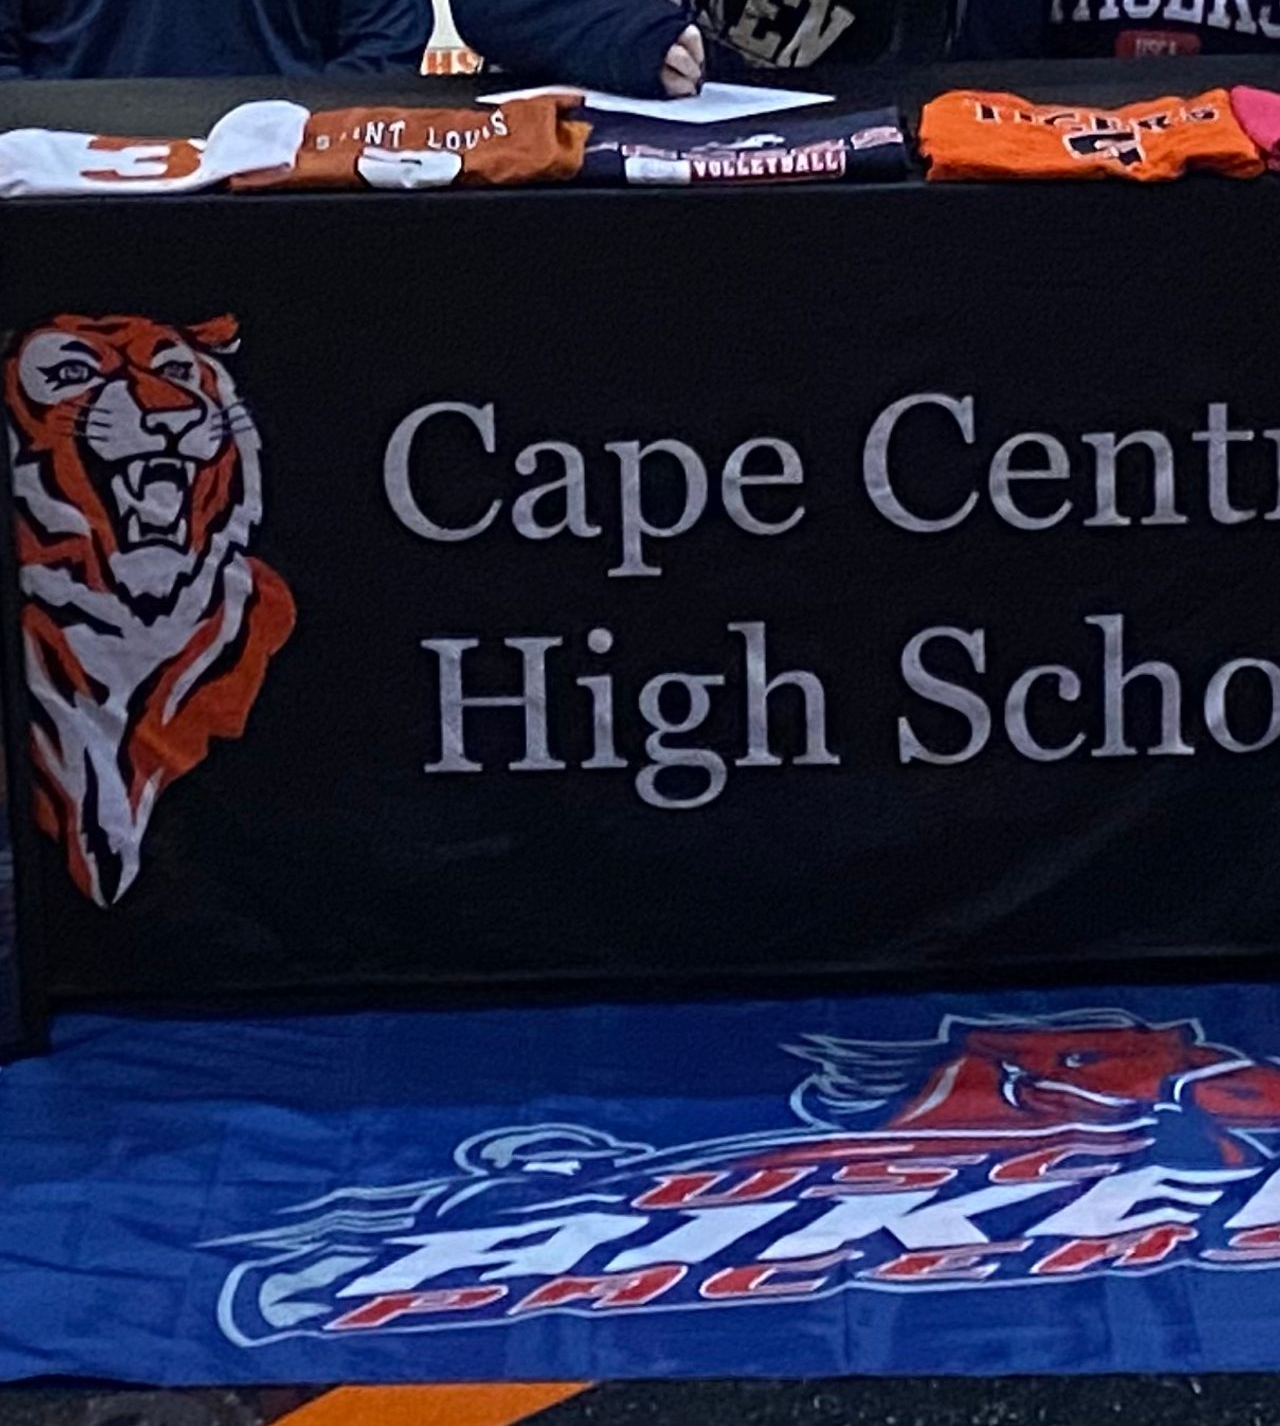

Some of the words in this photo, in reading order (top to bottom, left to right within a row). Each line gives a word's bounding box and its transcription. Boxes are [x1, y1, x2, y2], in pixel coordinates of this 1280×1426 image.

[692, 151, 838, 178] VOLLEYBALL
[382, 401, 807, 579] Cape
[420, 621, 841, 811] High
[631, 1139, 1149, 1210] USC
